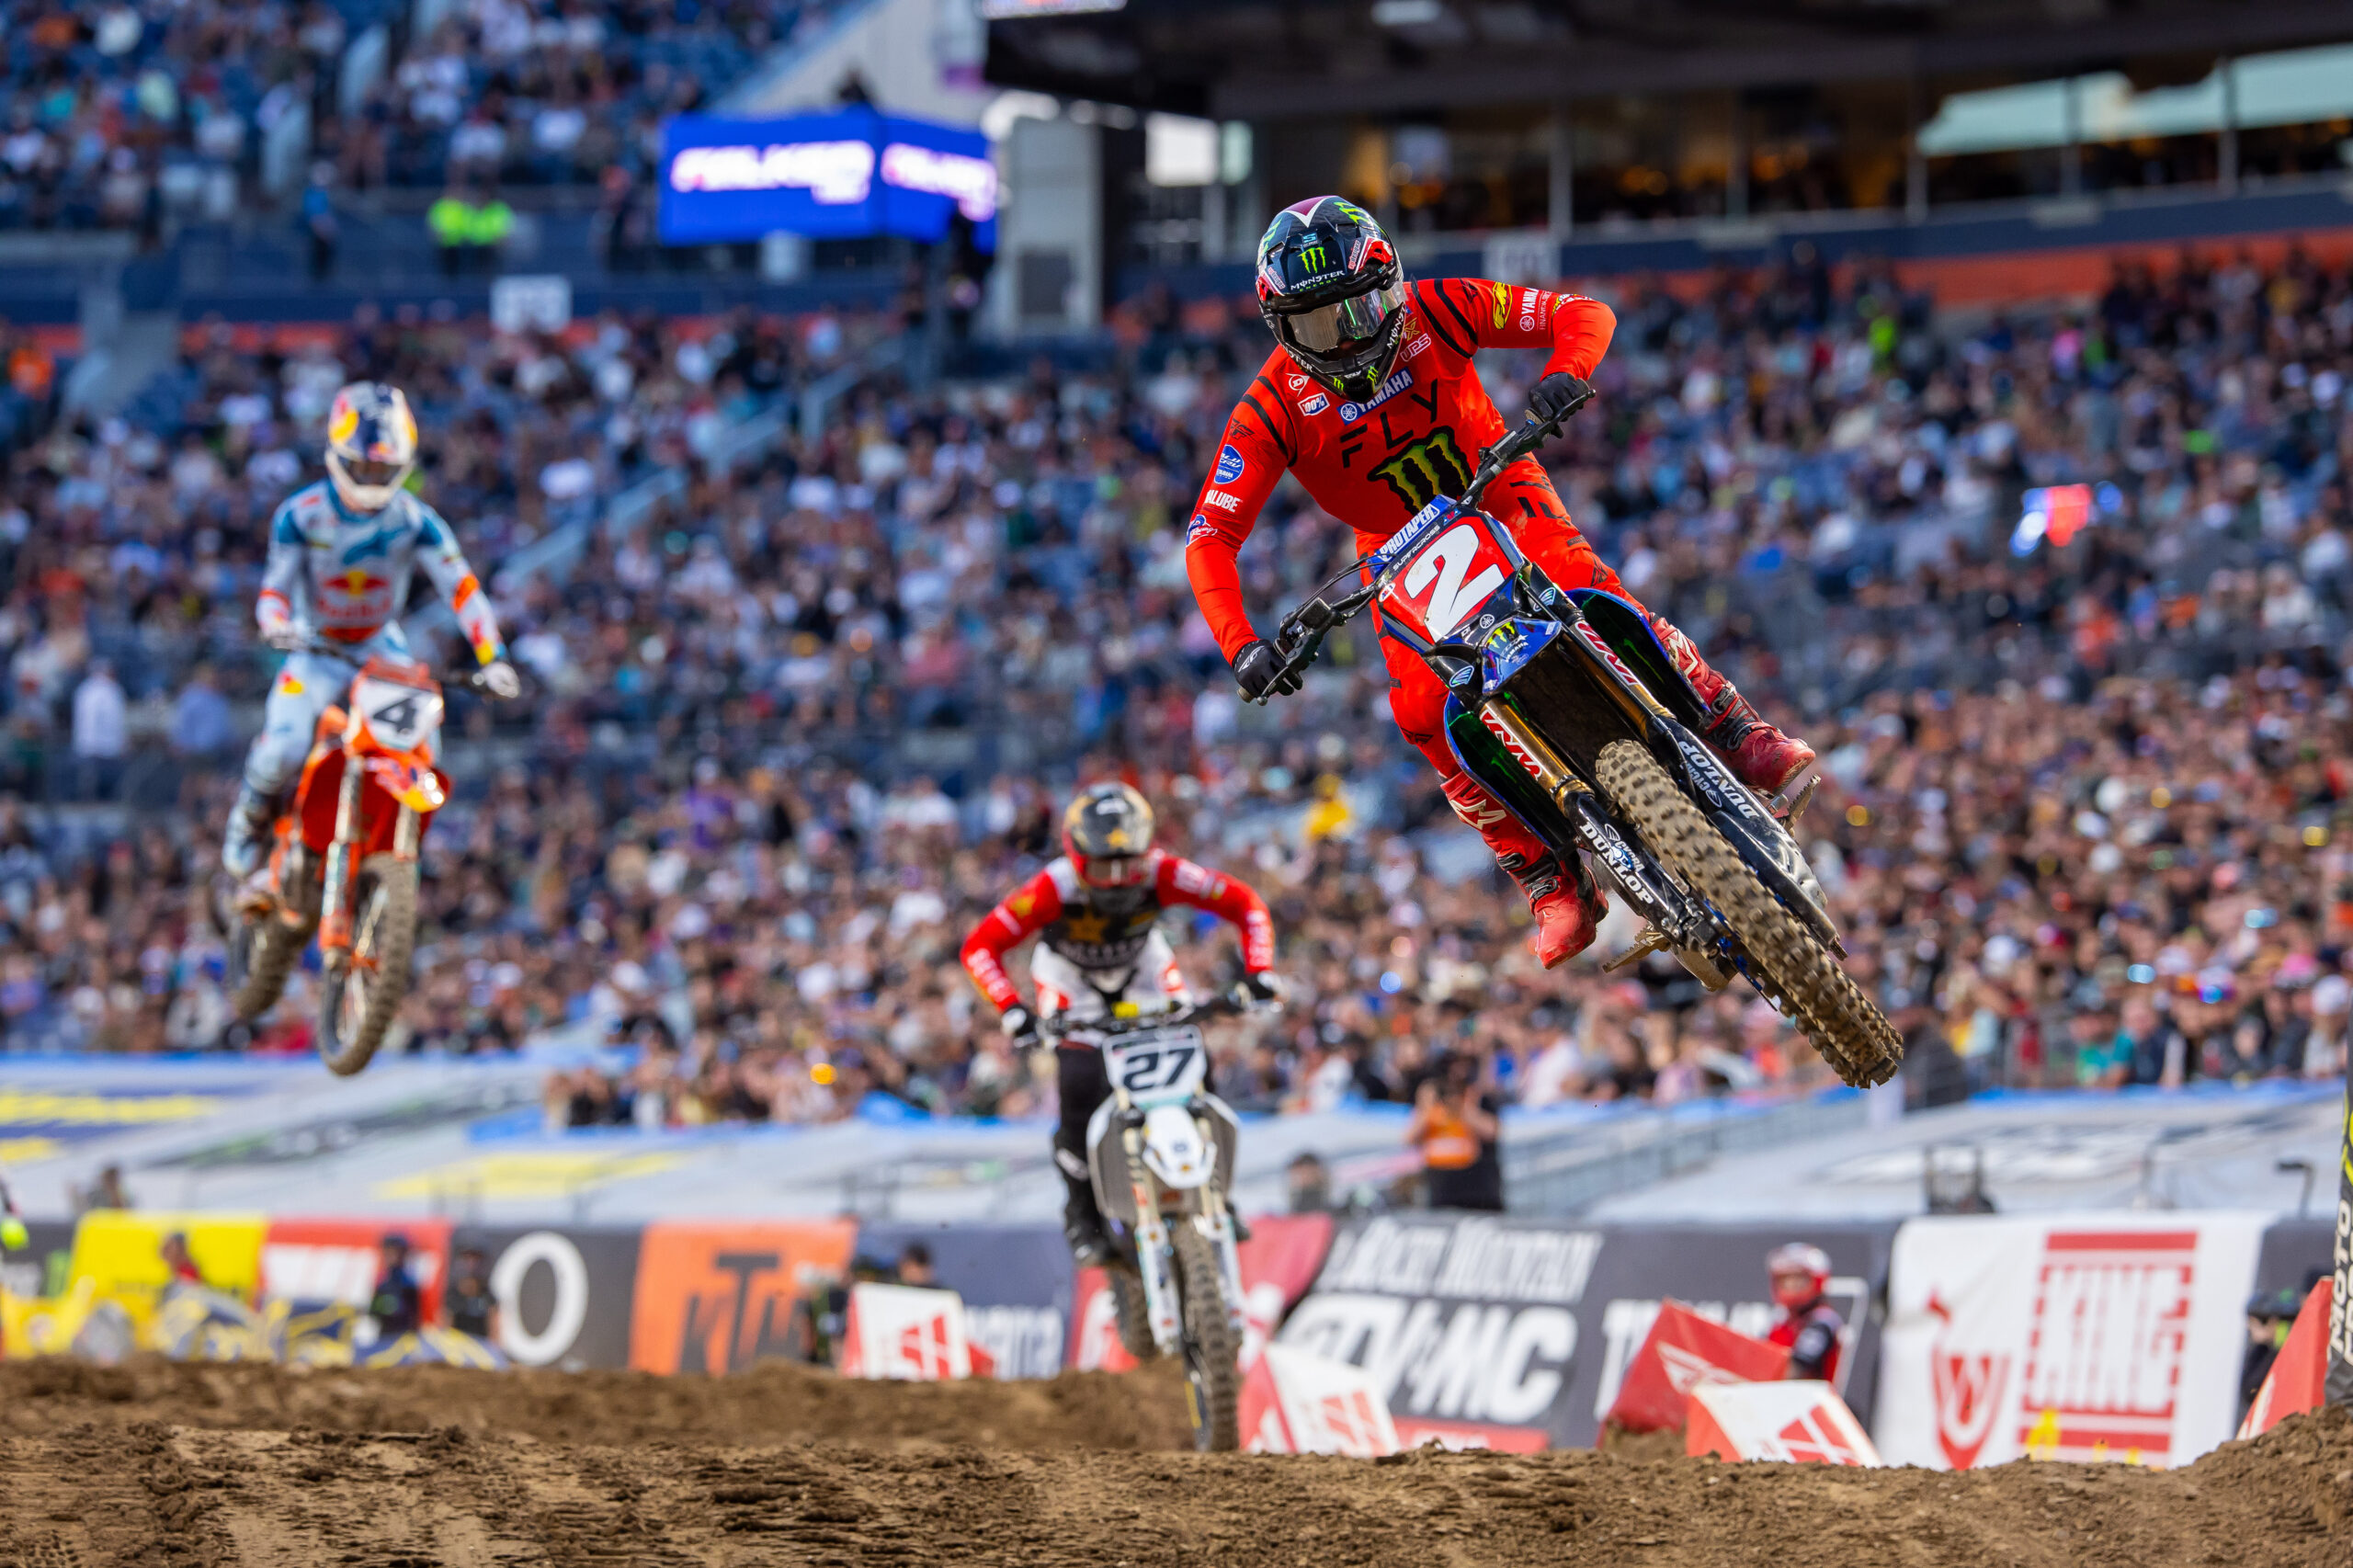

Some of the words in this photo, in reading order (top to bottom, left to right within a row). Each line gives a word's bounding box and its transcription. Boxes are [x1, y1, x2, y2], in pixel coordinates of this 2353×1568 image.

[1290, 270, 1346, 290] MONSTER
[1357, 369, 1413, 413] YAMAHA
[1379, 505, 1435, 558] PROTAPER
[1392, 525, 1440, 571] SUPERCROSS
[1404, 524, 1505, 643] 2
[373, 696, 417, 734] 4
[1677, 741, 1759, 819] DUNLOP
[1580, 822, 1654, 904] DUNLOP
[1123, 1048, 1195, 1091] 27
